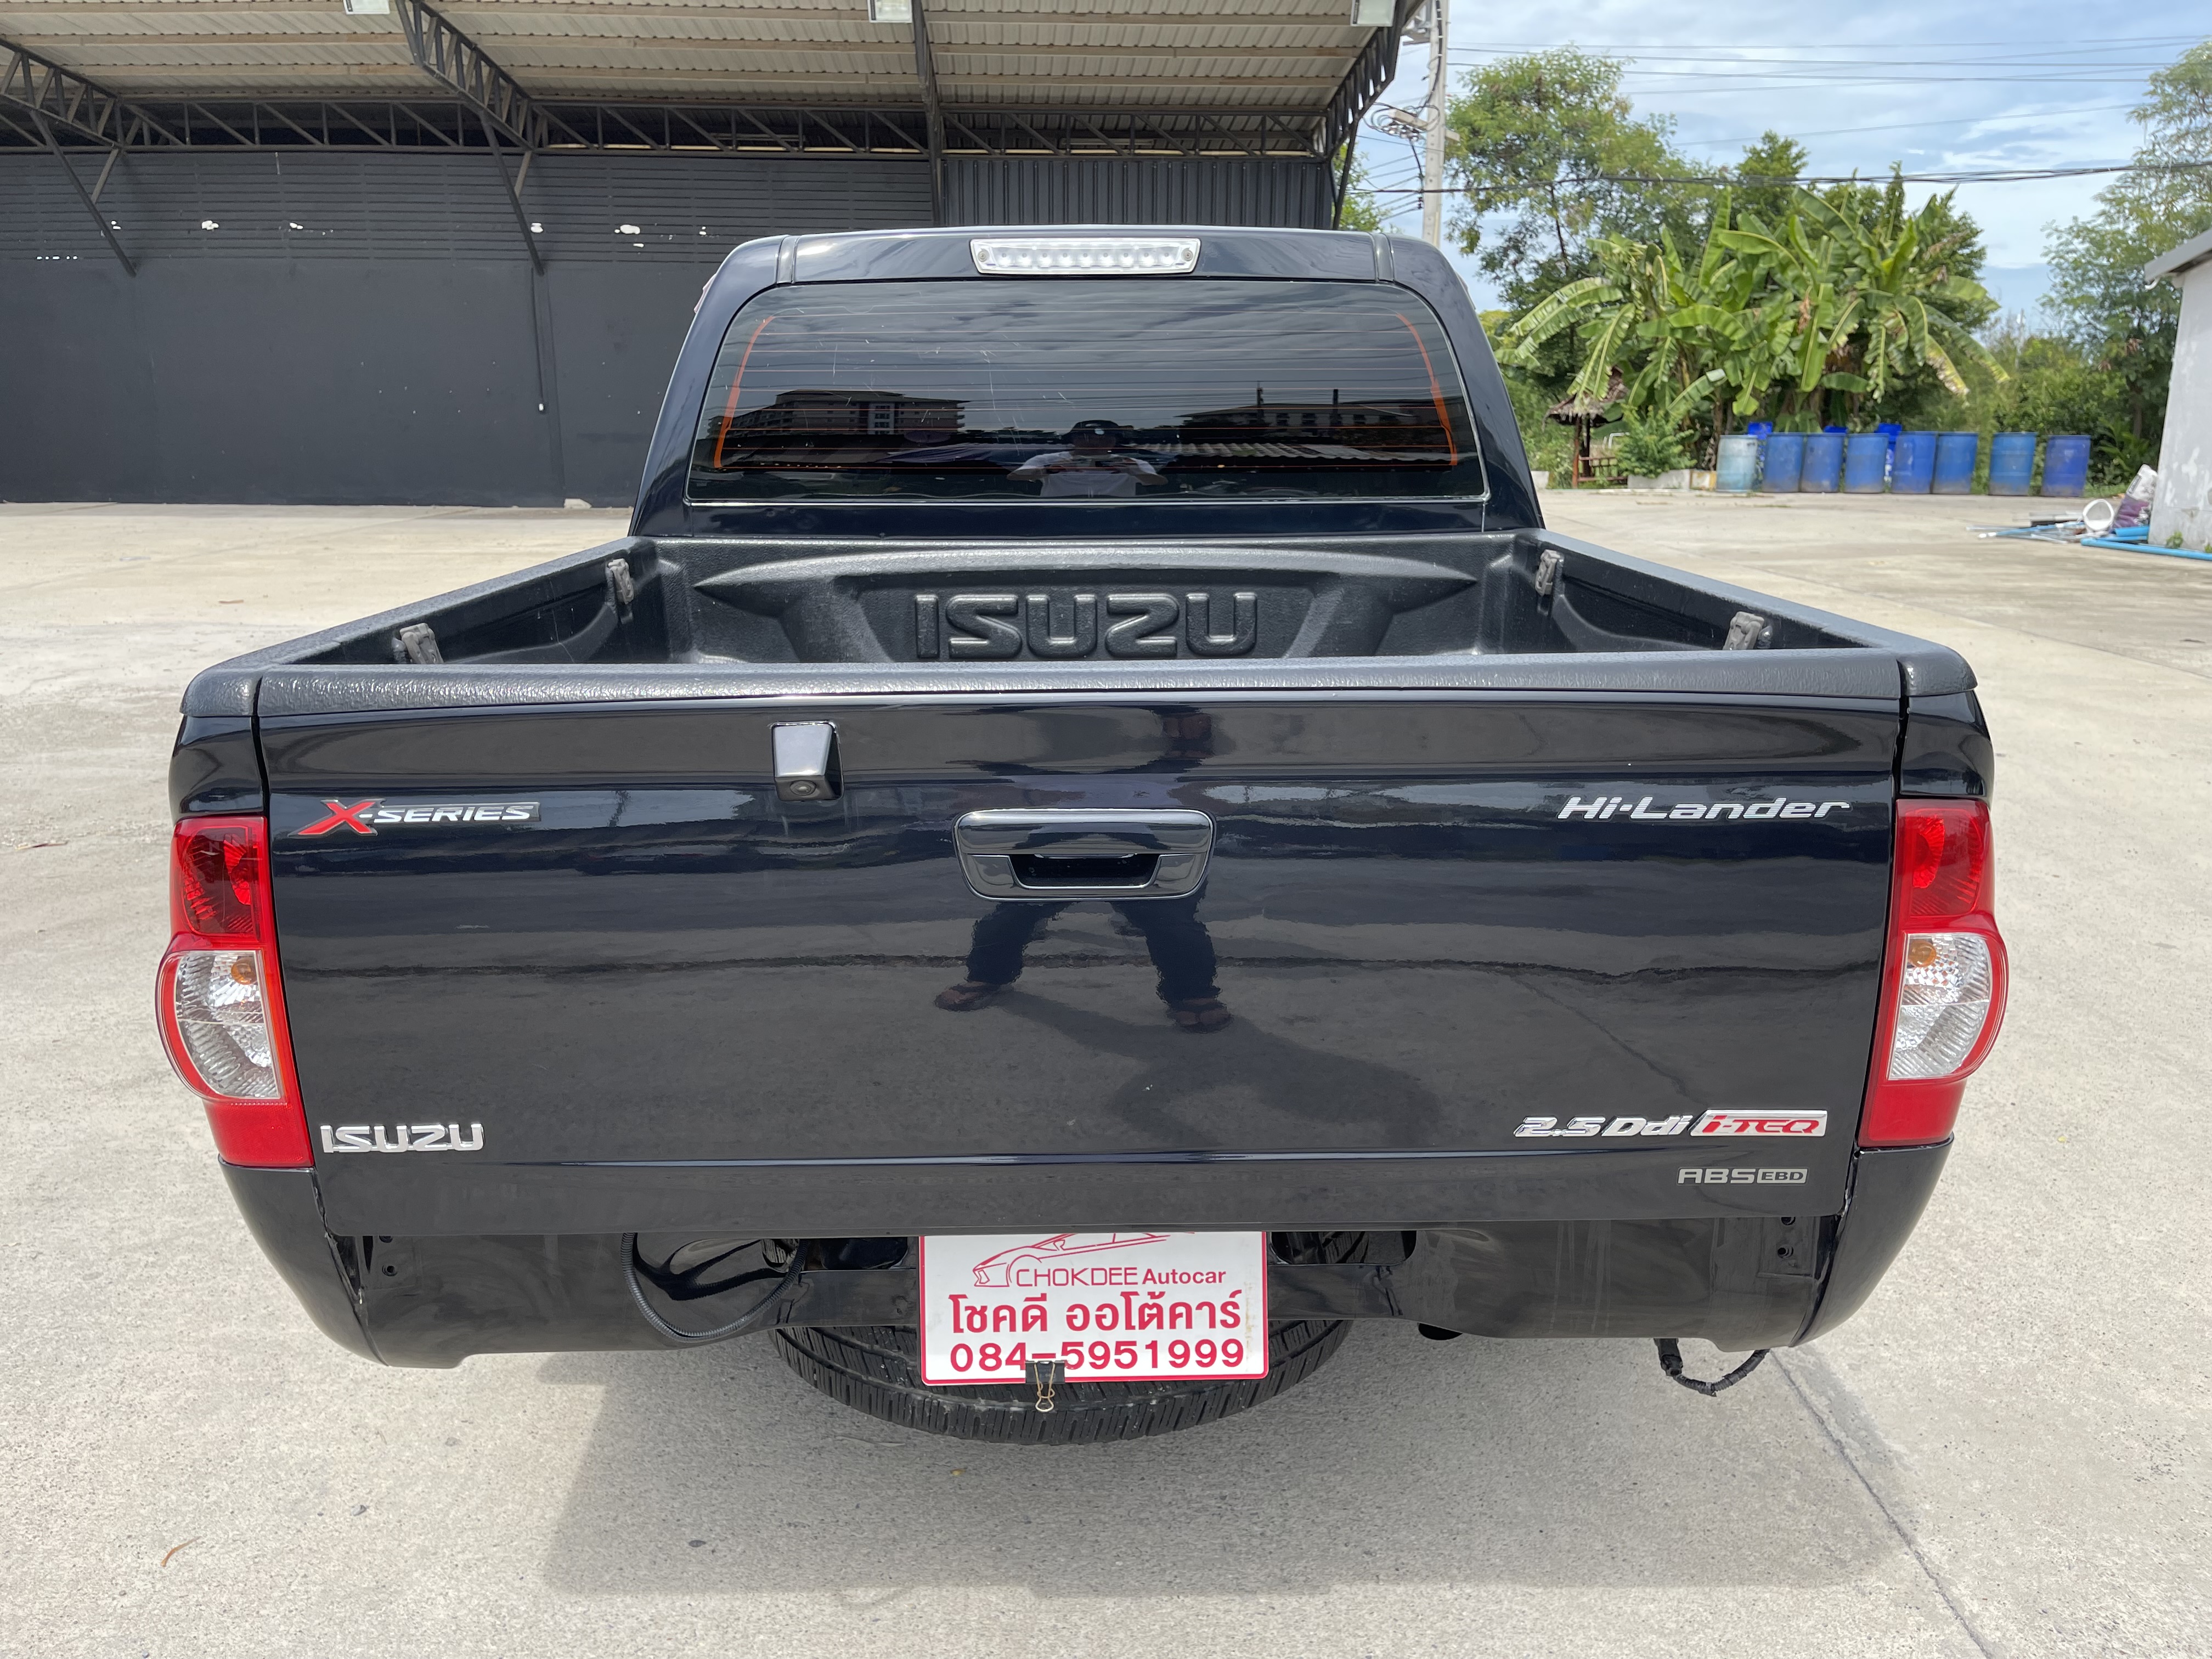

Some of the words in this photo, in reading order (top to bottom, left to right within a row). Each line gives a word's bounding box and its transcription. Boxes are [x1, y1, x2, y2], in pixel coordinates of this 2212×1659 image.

[914, 592, 1257, 658] ISUZU
[297, 799, 534, 834] X-SERIES
[1558, 796, 1851, 819] Hi-Lander
[319, 1123, 485, 1154] ISUZU
[1017, 1267, 1138, 1286] CHOKDEE
[1142, 1268, 1227, 1284] Autocar
[949, 1293, 1048, 1333] โชคดี
[1066, 1290, 1242, 1331] ออโต้คาร์
[950, 1339, 1244, 1372] 084-5951999
